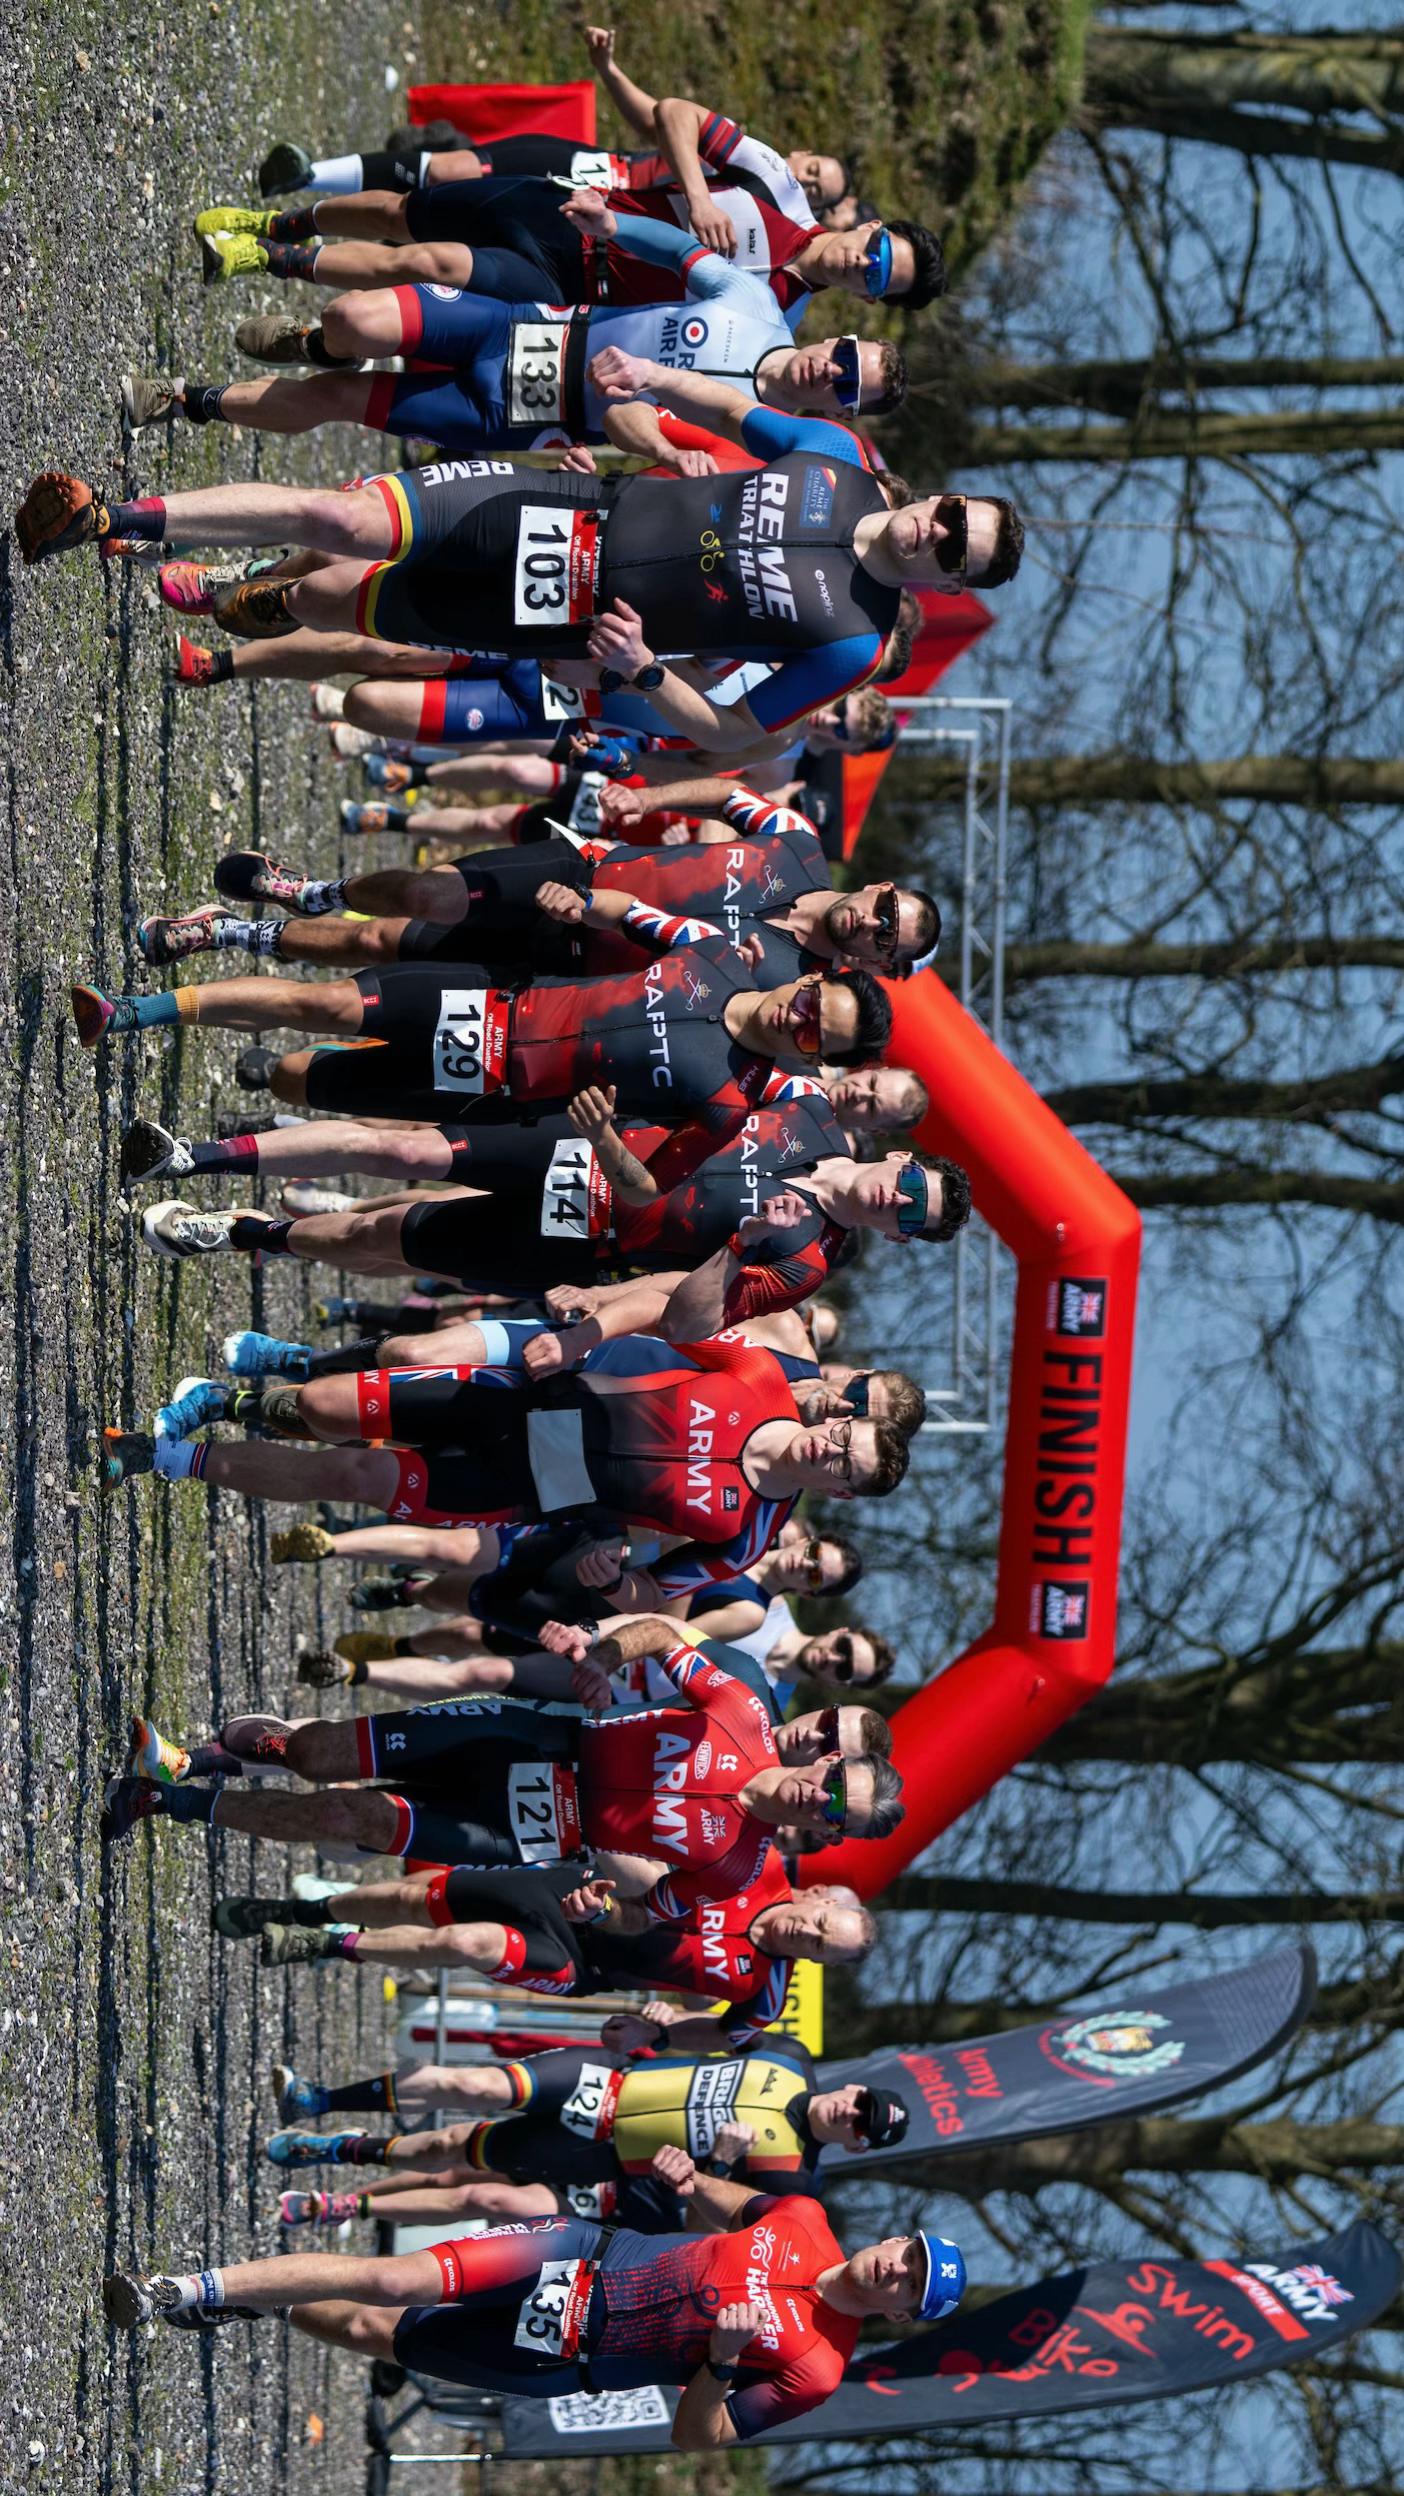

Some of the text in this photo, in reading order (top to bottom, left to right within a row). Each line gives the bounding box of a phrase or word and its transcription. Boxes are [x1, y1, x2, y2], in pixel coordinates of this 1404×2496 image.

[658, 316, 679, 353] AIR
[520, 337, 559, 409] 133
[418, 459, 515, 488] REME
[524, 524, 569, 610] 103
[572, 547, 580, 566] Road
[581, 550, 591, 584] ARMY
[737, 475, 766, 621] TRIATHLON
[756, 473, 798, 622] REME
[572, 567, 580, 600] Duathlon
[442, 1004, 481, 1080] 129
[494, 1026, 504, 1059] ARMY
[644, 962, 673, 1087] RAPTC
[549, 1152, 588, 1224] 114
[1061, 1283, 1083, 1334] ARMY
[686, 1399, 717, 1516] ARMY
[1032, 1351, 1102, 1565] FINISH
[1044, 1586, 1066, 1636] ARMY
[515, 1777, 556, 1846] 121
[563, 1797, 575, 1825] ARMY
[652, 1732, 691, 1856] ARMY
[700, 1808, 715, 1846] ARMY
[700, 1902, 730, 1980] RMY
[567, 2077, 604, 2129] 124
[694, 2070, 714, 2152] DEFENCE
[526, 2271, 572, 2342] 135
[567, 2292, 577, 2309] Road
[573, 2295, 585, 2326] ARMY
[761, 2289, 784, 2332] TRAINING
[1127, 2263, 1255, 2361] Swim
[1243, 2263, 1339, 2321] ARMY
[563, 2310, 573, 2339] Duathlon
